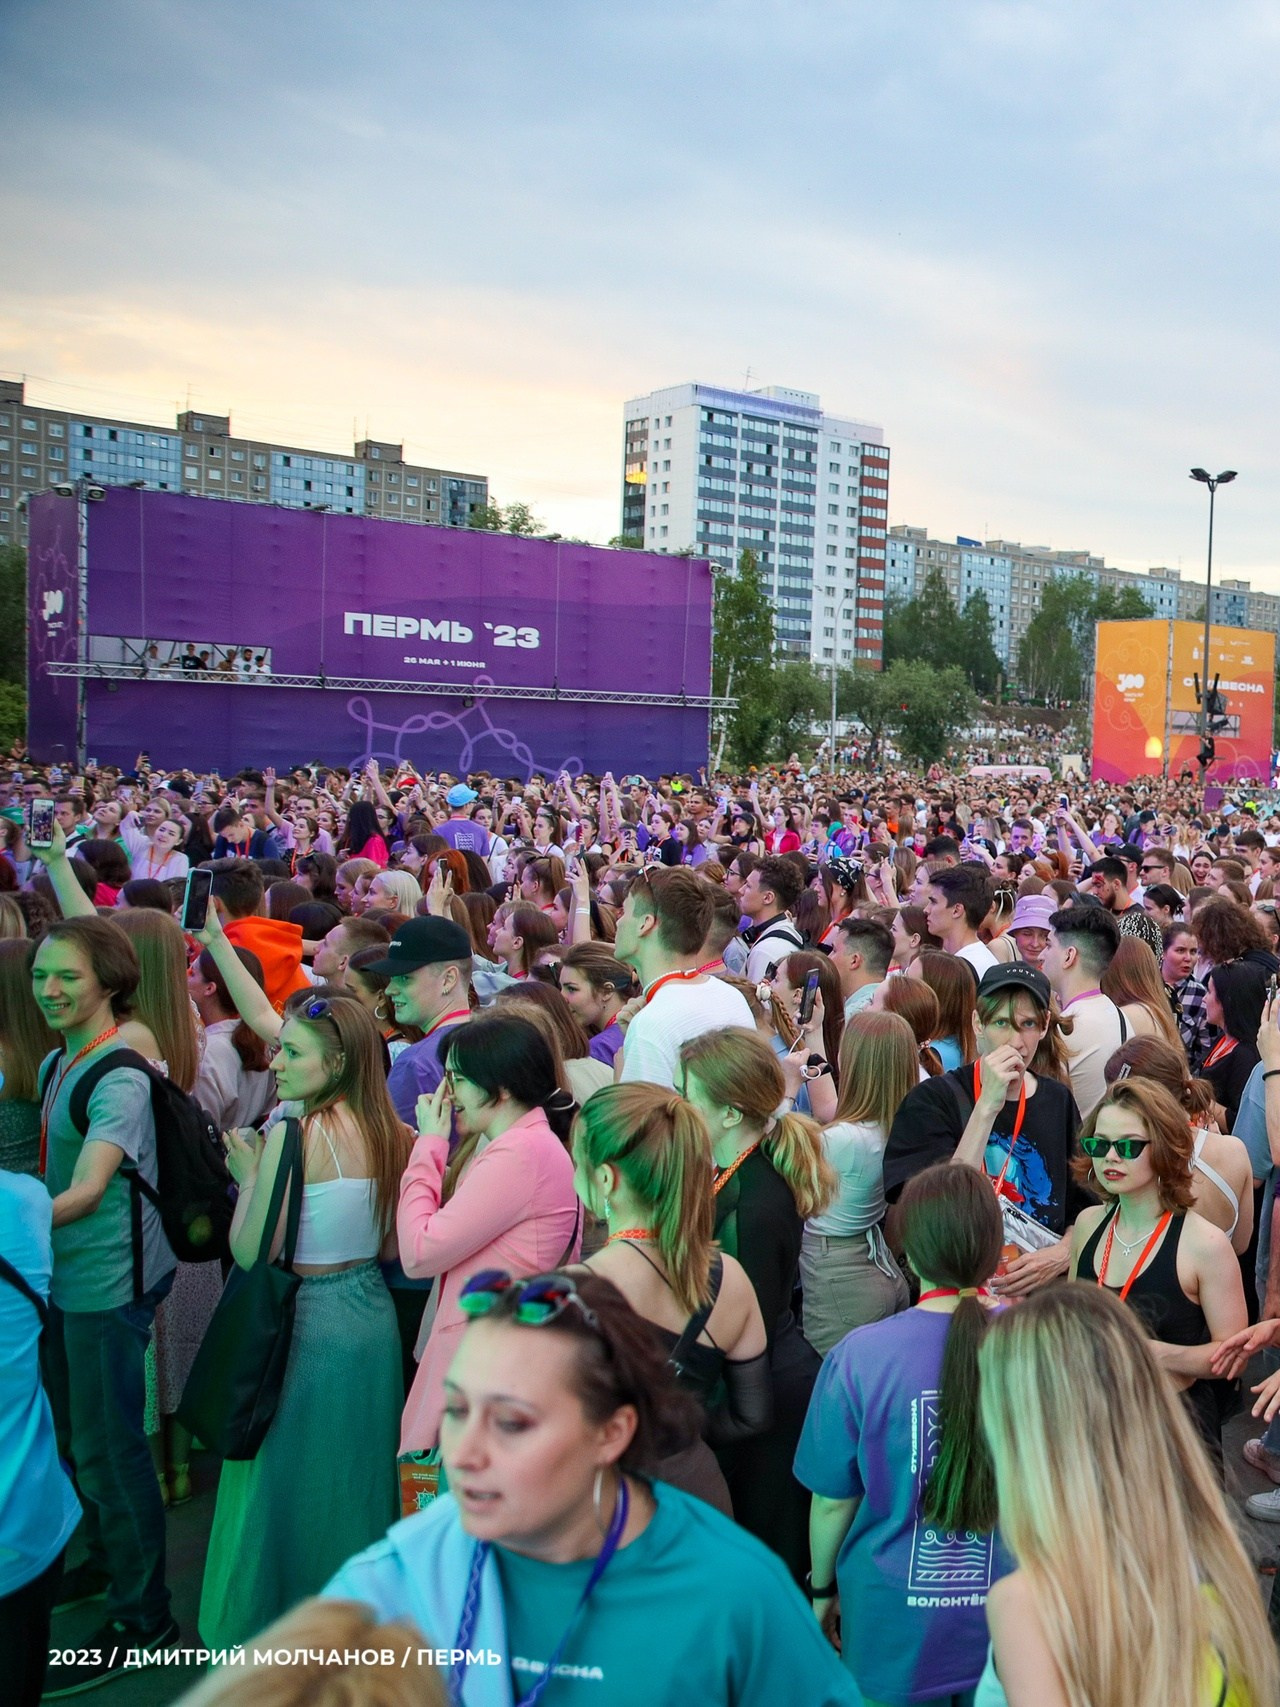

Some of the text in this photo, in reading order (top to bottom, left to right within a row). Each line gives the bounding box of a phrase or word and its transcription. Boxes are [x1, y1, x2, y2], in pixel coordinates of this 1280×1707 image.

[344, 611, 474, 644] ПЕРМЬ
[403, 656, 417, 664] 26
[418, 657, 441, 666] МАЯ
[456, 660, 486, 669] ИЮНЯ
[1006, 968, 1035, 977] YOUTH
